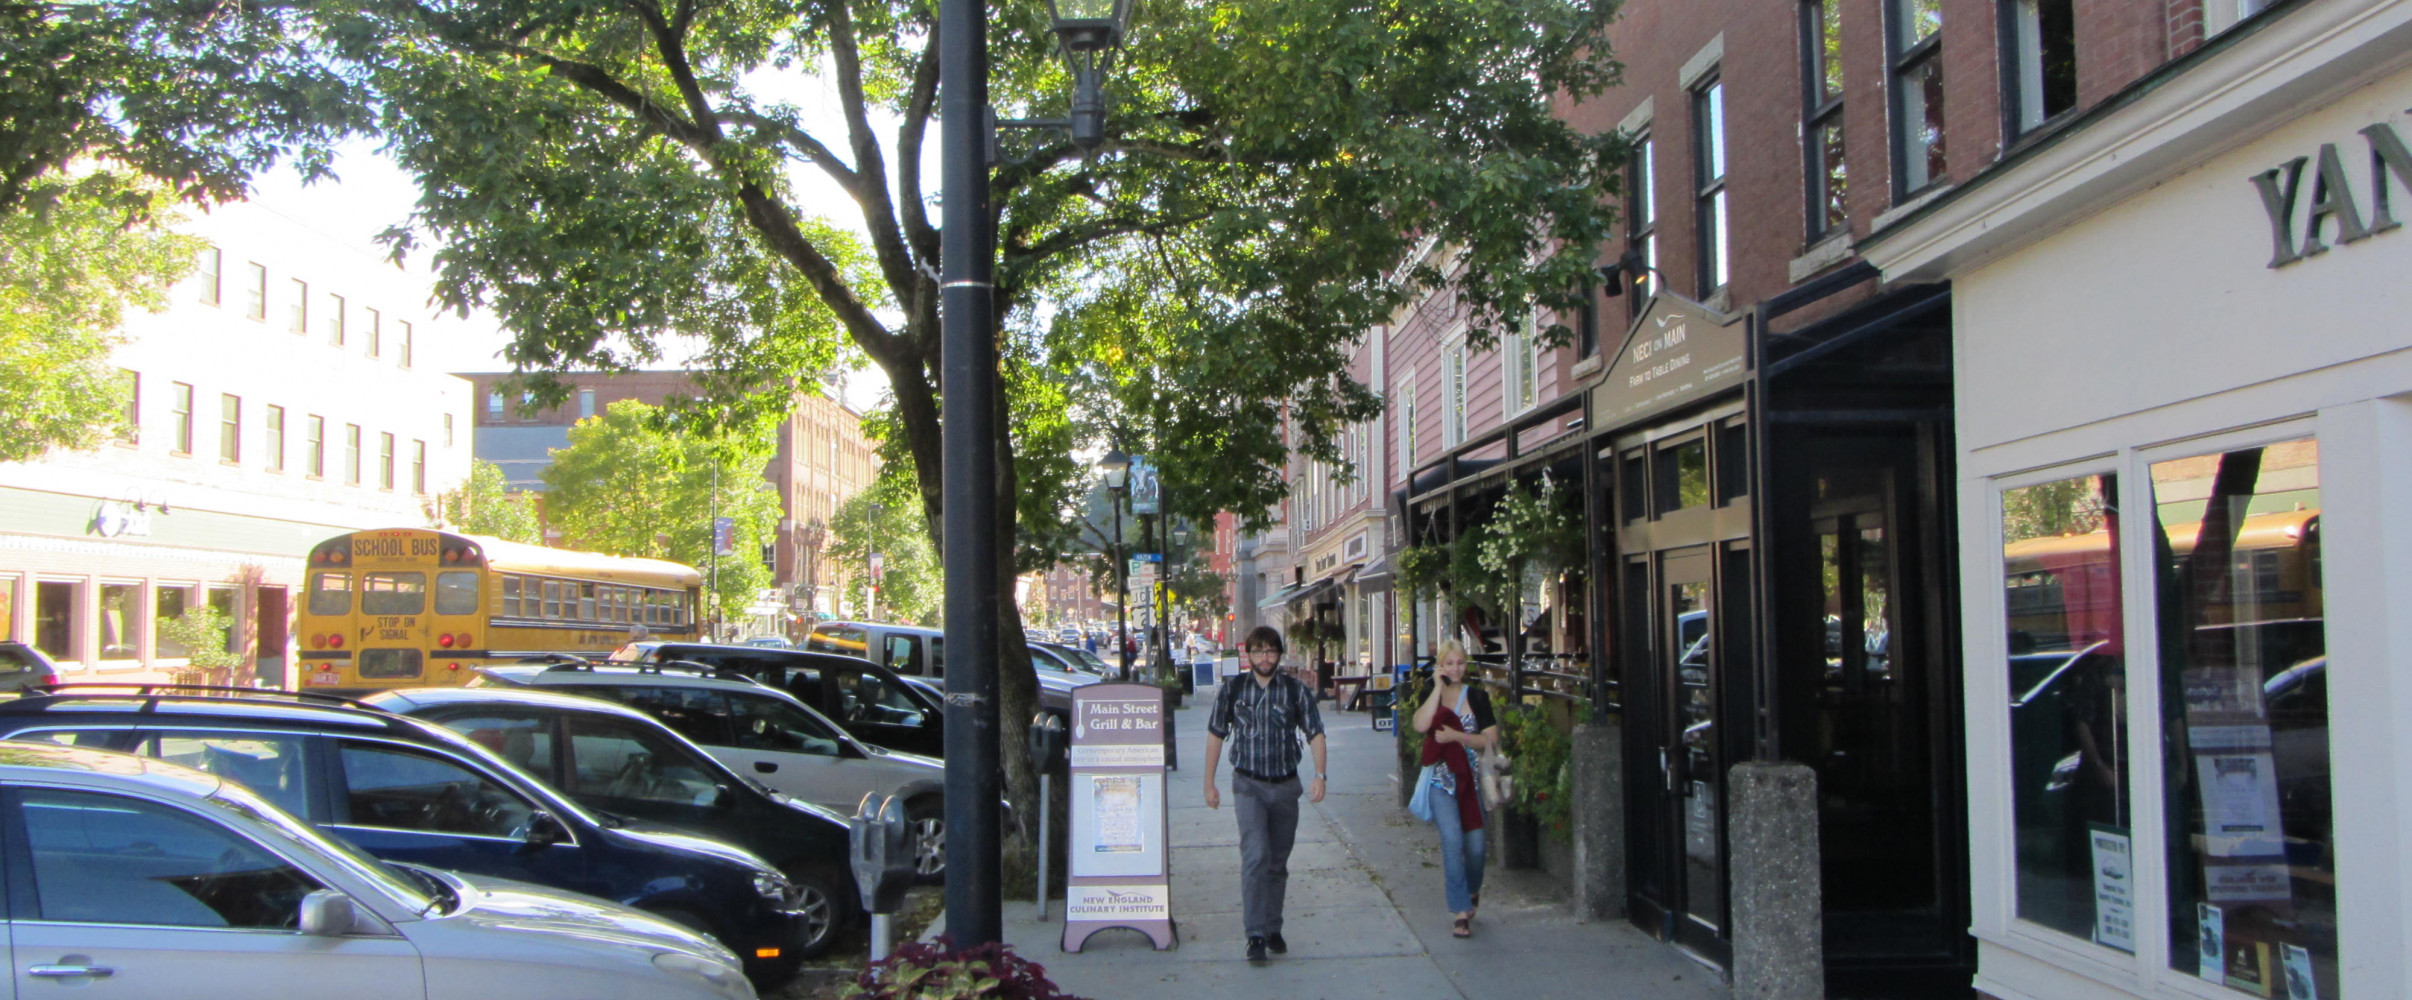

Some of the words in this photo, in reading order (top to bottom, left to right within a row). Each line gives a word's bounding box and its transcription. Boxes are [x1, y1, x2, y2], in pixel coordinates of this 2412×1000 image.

[1633, 340, 1652, 364] NECI
[1664, 323, 1686, 349] MAIN
[354, 539, 405, 556] SCHOOL
[412, 538, 438, 555] BUS
[1131, 561, 1141, 574] P
[377, 617, 399, 628] STOP
[404, 617, 415, 628] ON
[380, 629, 409, 640] SIGNAL
[1090, 703, 1119, 714] Main
[1122, 703, 1158, 714] Street
[1090, 718, 1118, 730] Grill
[1121, 718, 1132, 730] &
[1135, 718, 1158, 730] Bar
[1083, 897, 1105, 905] NEW
[1108, 896, 1153, 904] ENGLAND
[1070, 905, 1116, 913] CULINARY
[1119, 904, 1165, 913] INSTITUTE
